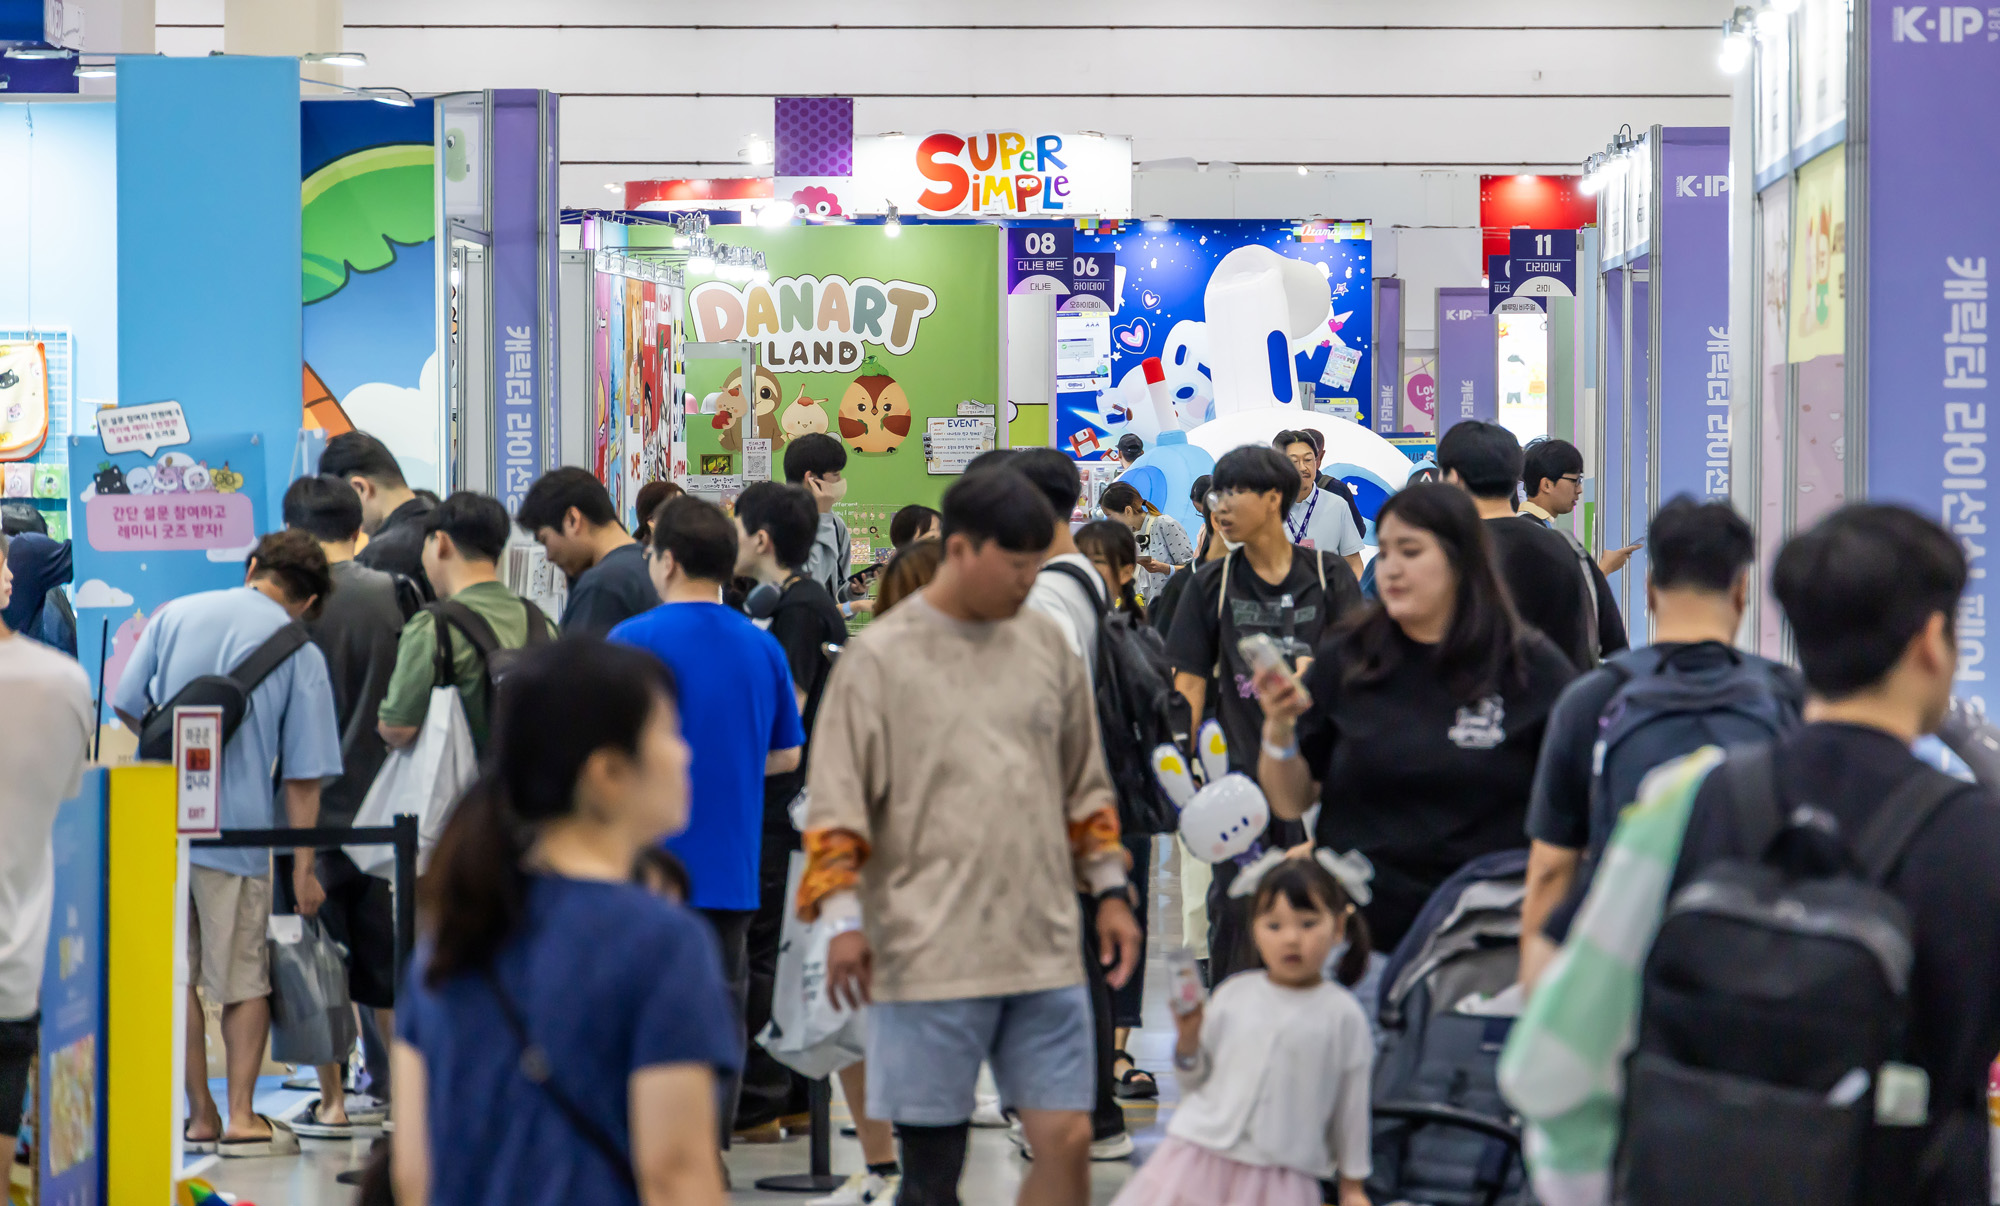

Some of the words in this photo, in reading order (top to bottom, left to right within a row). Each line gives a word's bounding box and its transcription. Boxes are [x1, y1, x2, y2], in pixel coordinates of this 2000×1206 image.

[1025, 232, 1056, 255] 08
[1535, 234, 1552, 256] 11
[1017, 260, 1044, 271] 다나트
[1046, 260, 1064, 271] 랜드
[1073, 256, 1099, 277] 06
[1030, 282, 1051, 291] 다나트
[697, 281, 930, 348] DANART
[1069, 301, 1101, 309] 오하이데이
[1943, 256, 1988, 388] 캐릭터
[504, 325, 532, 405] 캐릭터
[768, 341, 857, 366] LAND
[1706, 325, 1730, 406] 캐릭터
[1381, 385, 1394, 421] 캐릭터
[1461, 380, 1474, 418] 캐릭터
[947, 419, 980, 428] EVENT
[1705, 414, 1730, 500] 라이선
[1942, 402, 1987, 579] 라이선
[112, 506, 139, 521] 간단
[144, 505, 169, 521] 설문
[174, 505, 227, 520] 참여하고
[117, 524, 157, 540] 레미니
[162, 524, 188, 539] 굿즈
[192, 523, 223, 538] 받자!
